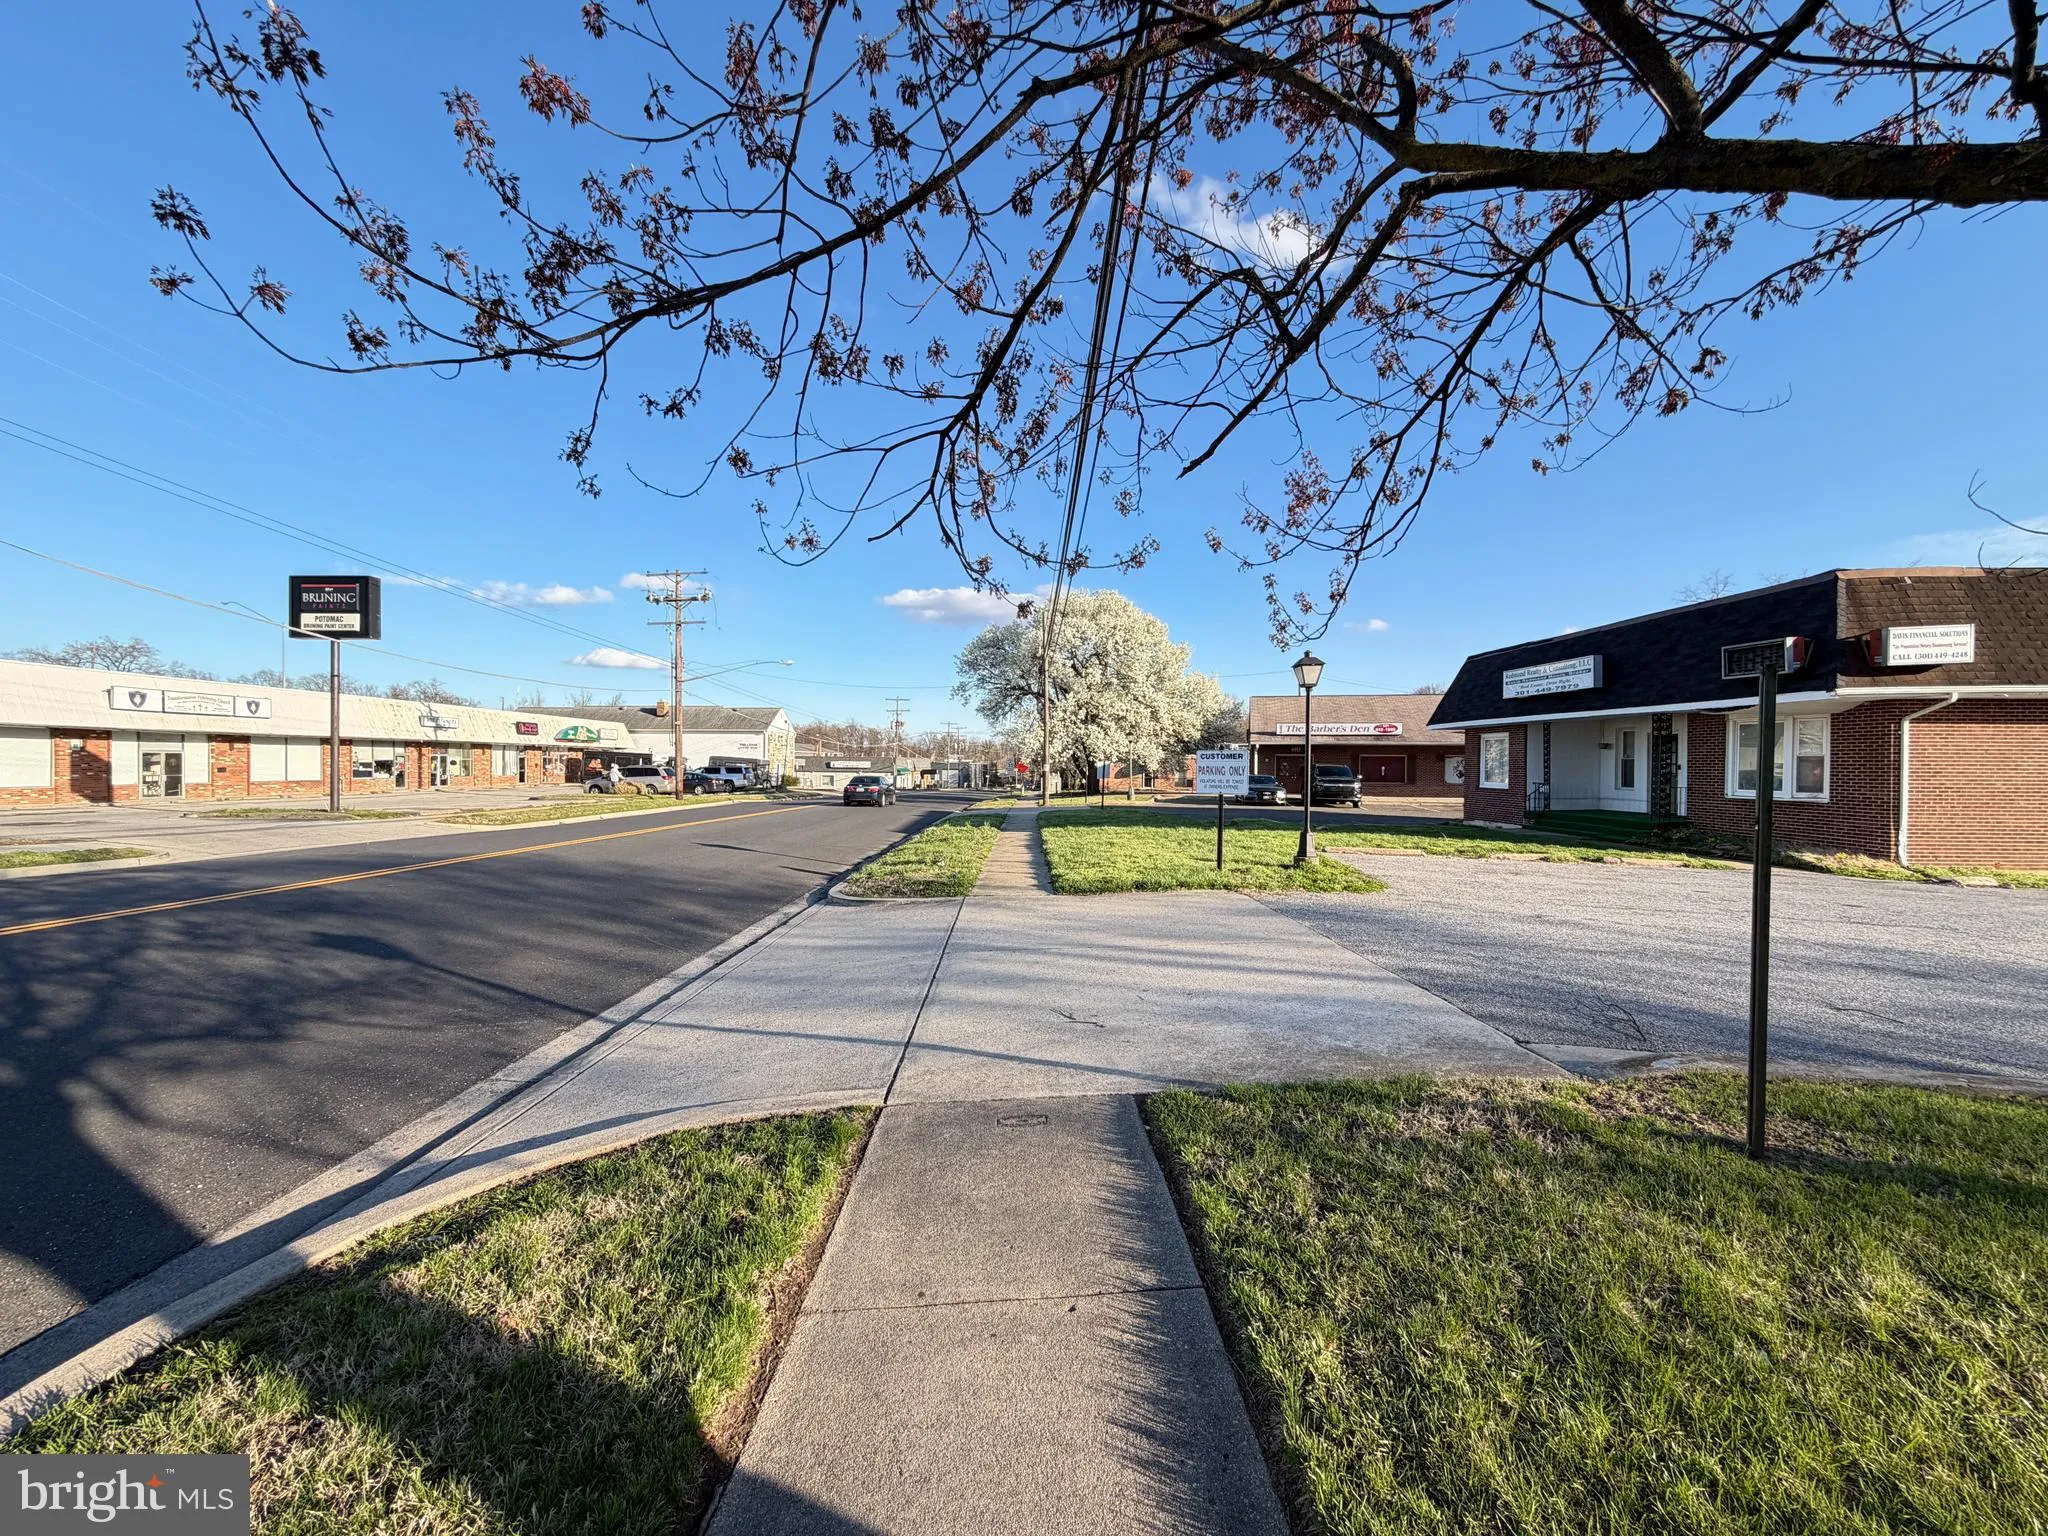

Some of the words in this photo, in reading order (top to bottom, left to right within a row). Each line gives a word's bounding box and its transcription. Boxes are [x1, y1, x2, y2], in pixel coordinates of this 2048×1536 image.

[302, 592, 356, 603] BRUNING
[314, 615, 344, 623] POTOMAC
[1909, 631, 1938, 639] FINANCIAL
[1939, 630, 1969, 638] SOLUTIONS
[1892, 653, 1912, 661] CALL
[1578, 659, 1592, 668] LLC
[1286, 724, 1304, 733] The
[1309, 724, 1347, 733] Barber's
[1349, 724, 1370, 733] Den
[1198, 765, 1226, 776] PARKING
[1228, 765, 1246, 776] ONLY
